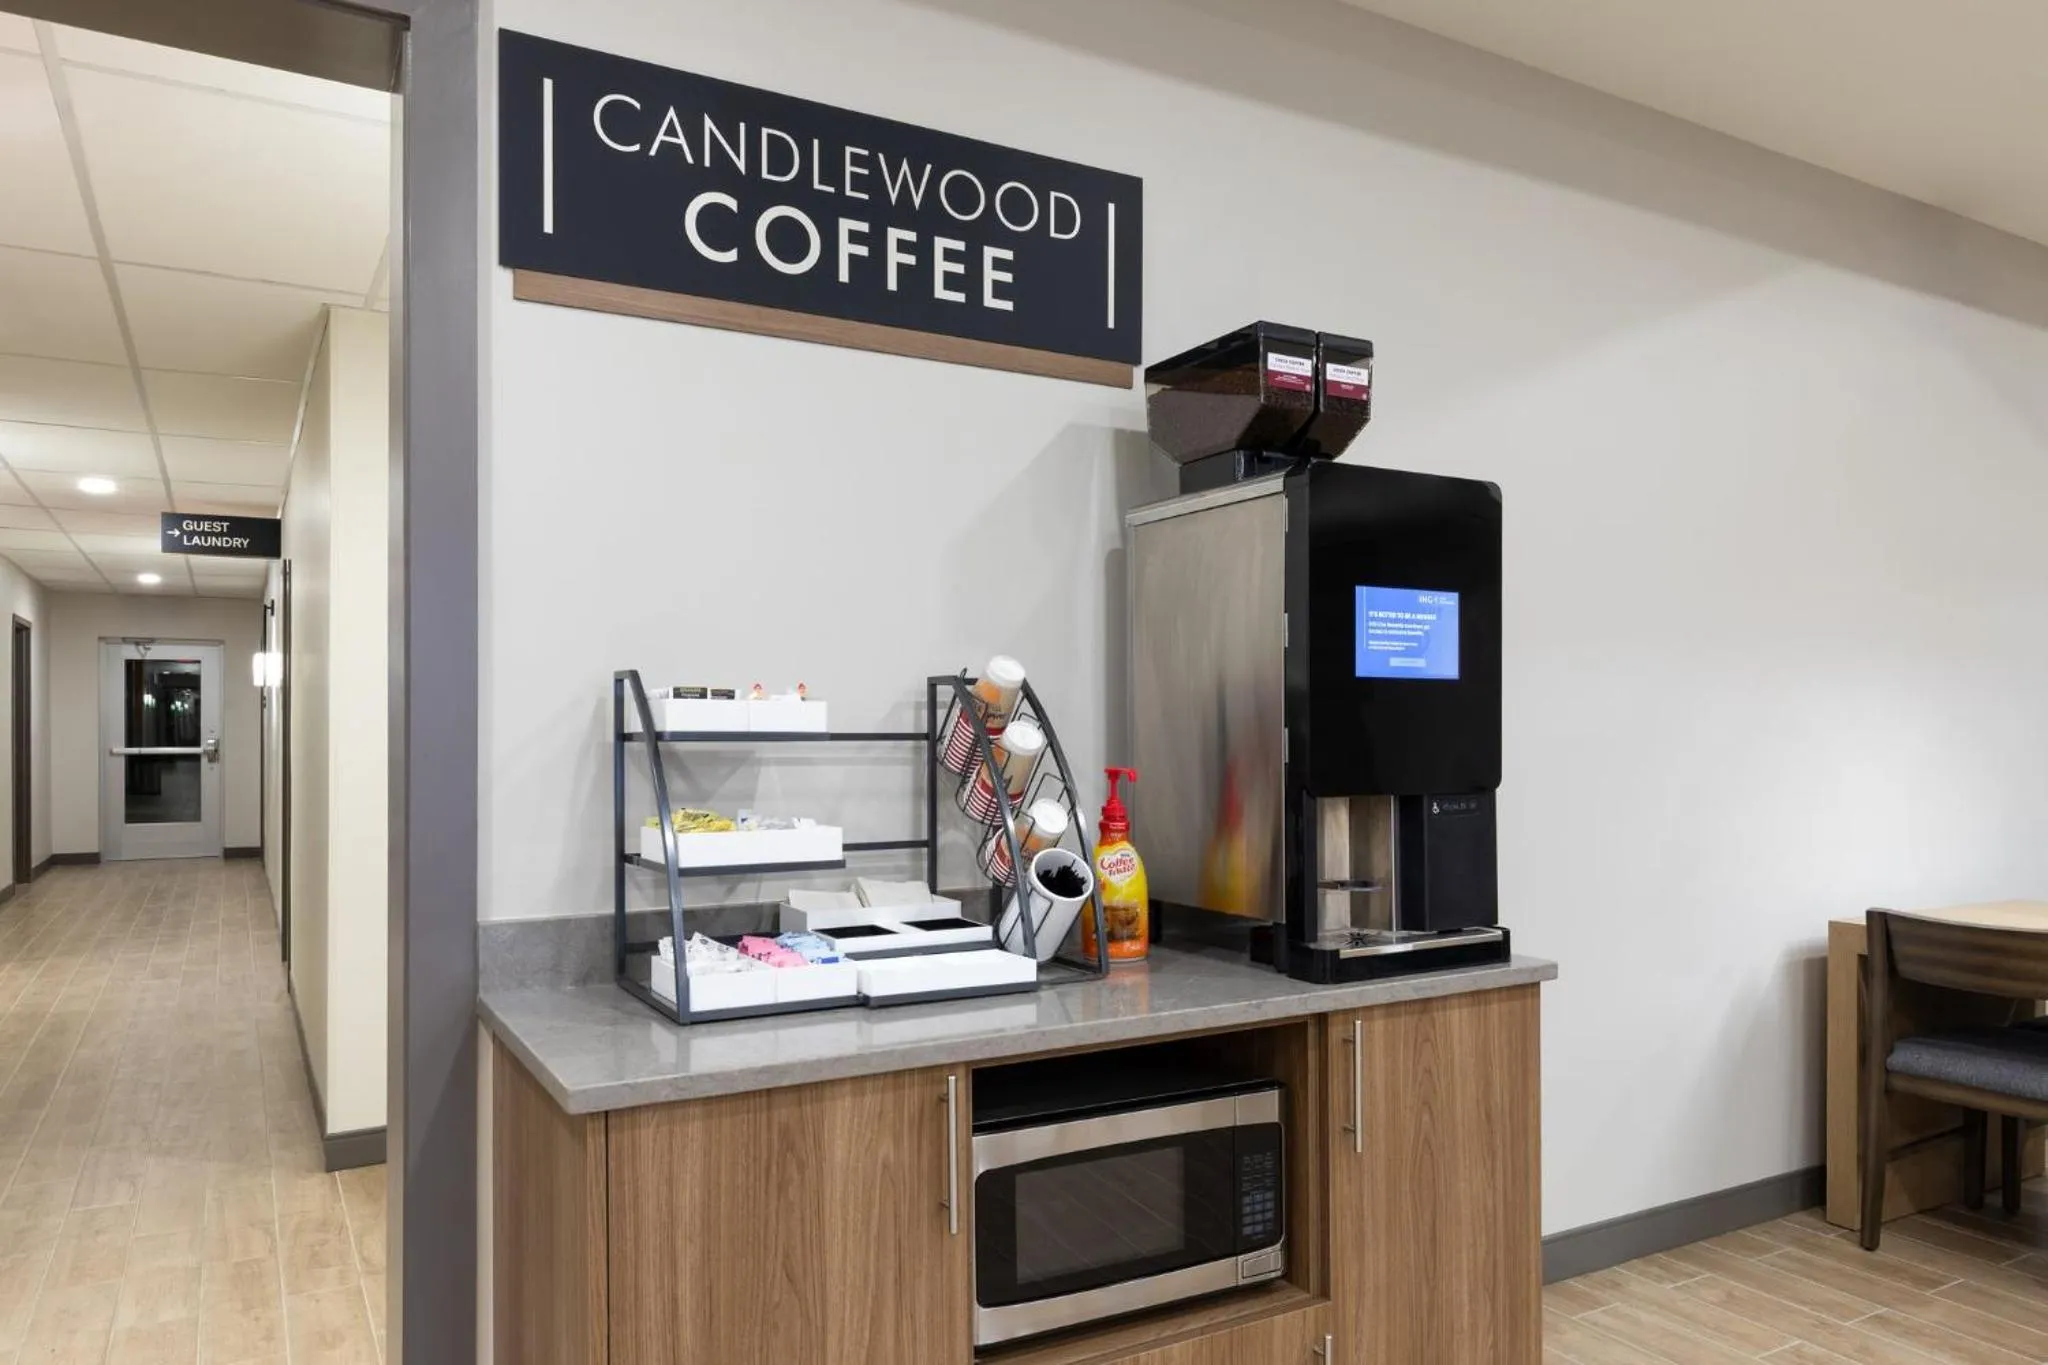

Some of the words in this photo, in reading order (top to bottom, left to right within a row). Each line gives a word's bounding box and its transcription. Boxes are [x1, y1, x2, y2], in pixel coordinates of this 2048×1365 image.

[592, 93, 1082, 241] CANDLEWOOD
[684, 191, 1014, 312] COFFEE
[182, 519, 230, 533] GUEST
[182, 535, 250, 549] LAUNDRY
